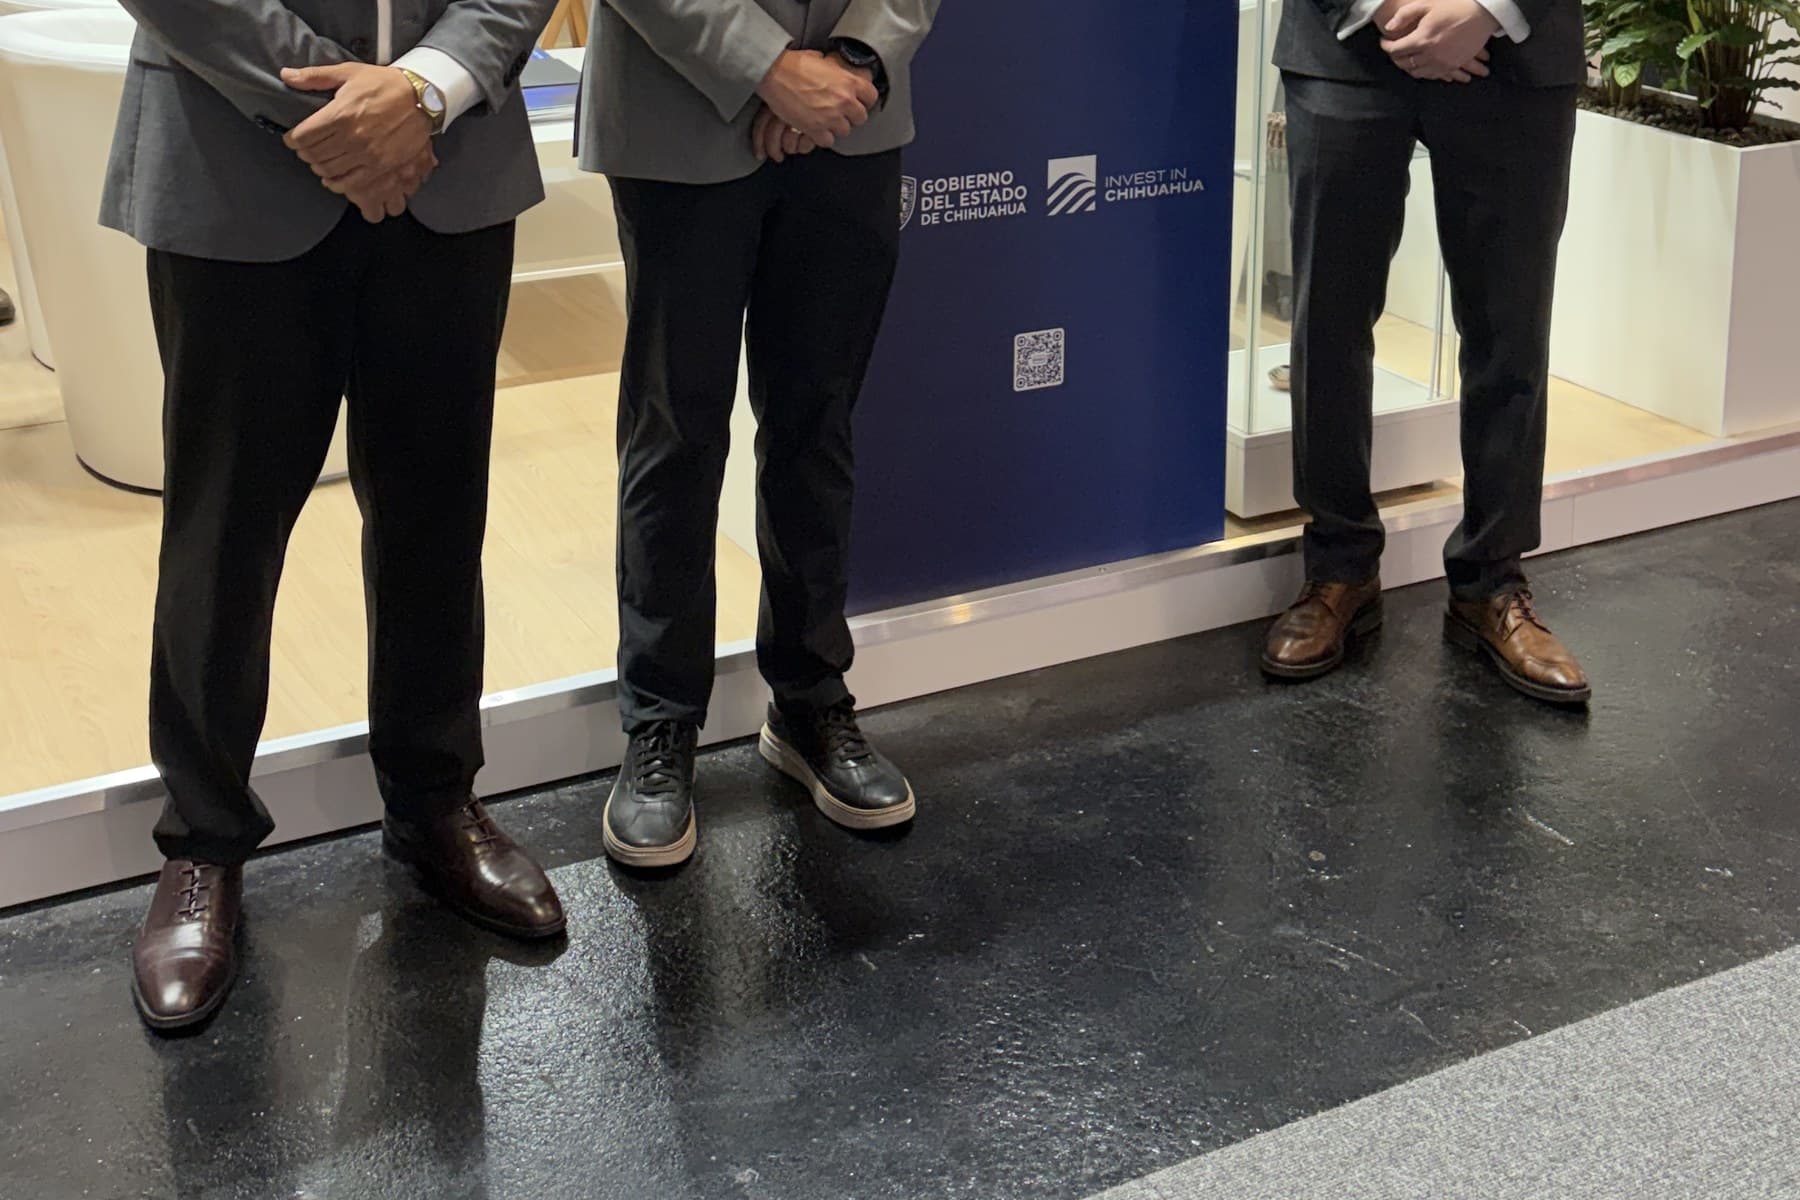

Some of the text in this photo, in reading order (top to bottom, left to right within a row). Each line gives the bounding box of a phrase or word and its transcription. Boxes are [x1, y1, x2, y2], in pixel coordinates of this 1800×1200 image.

[921, 170, 1014, 194] GOBIERNO
[1105, 167, 1188, 188] INVEST IN
[921, 185, 1028, 212] DEL ESTADO
[1105, 180, 1205, 202] CHIHUAHUA
[921, 202, 1027, 226] DE CHIHUAHUA
